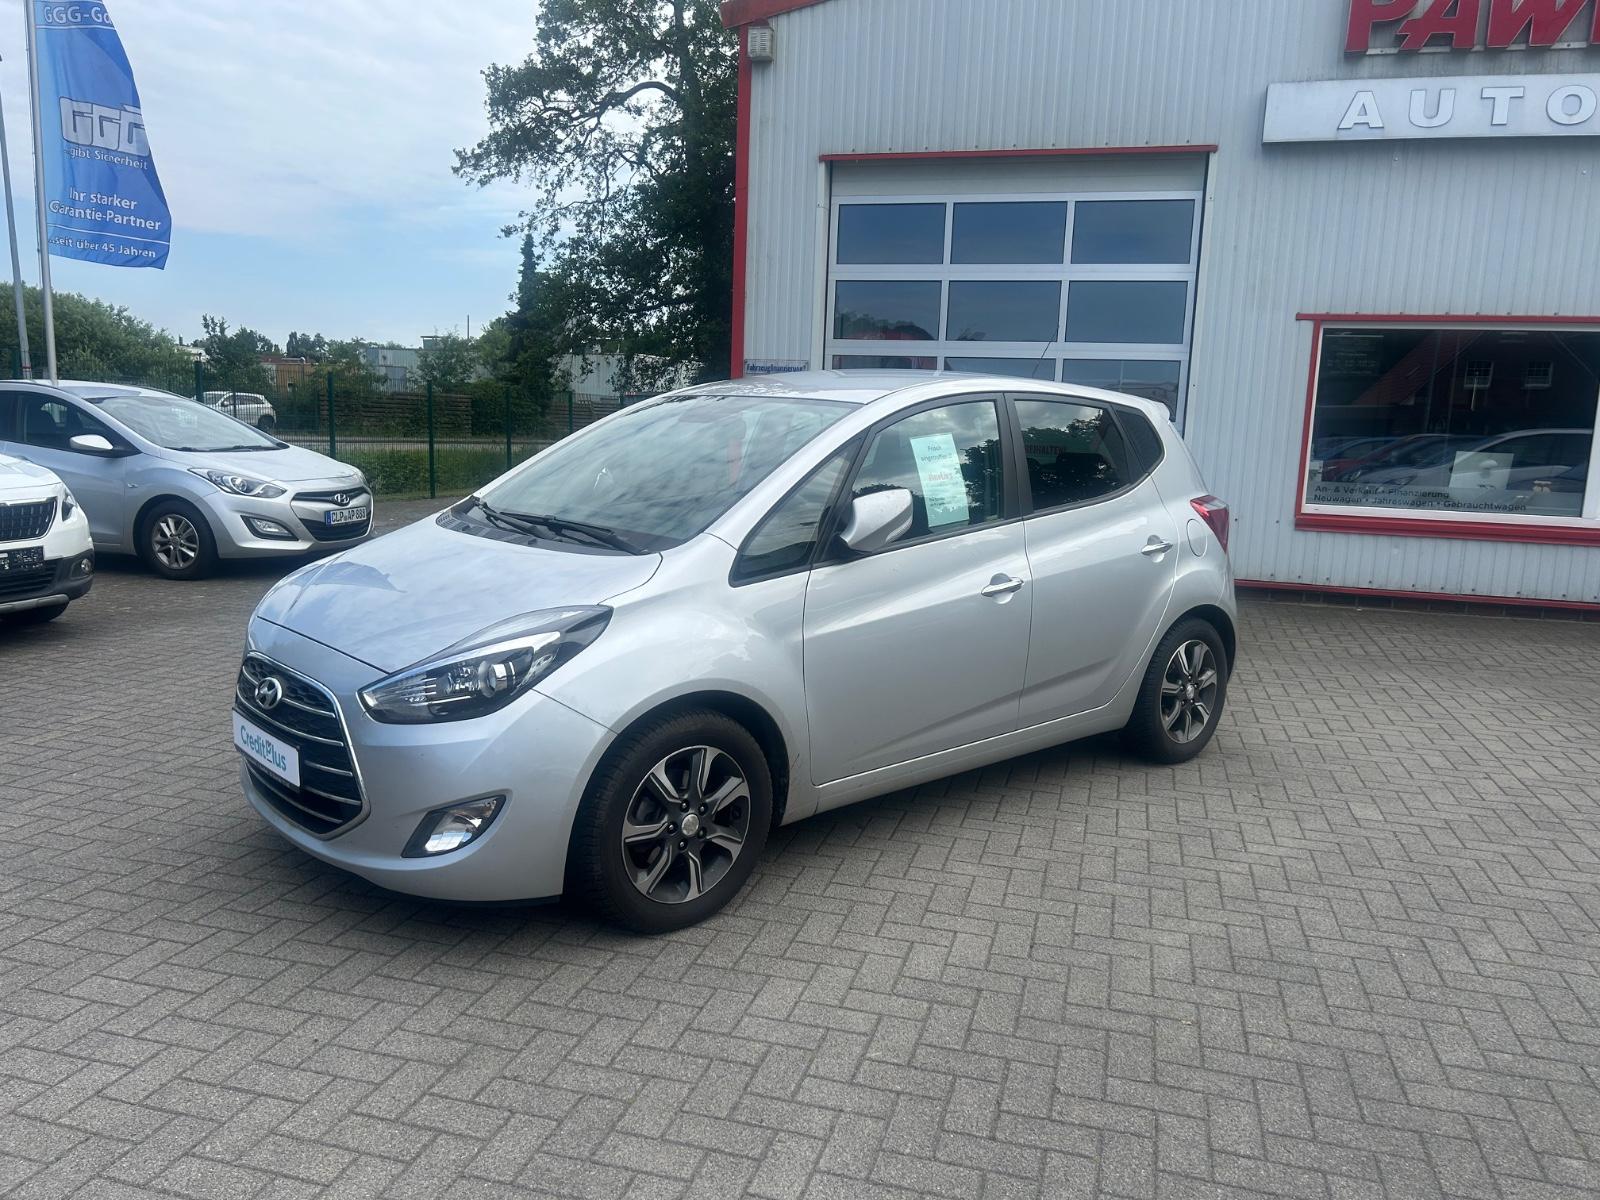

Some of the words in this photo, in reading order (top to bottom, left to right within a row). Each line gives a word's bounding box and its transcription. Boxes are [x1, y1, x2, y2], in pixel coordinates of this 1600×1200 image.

[1337, 84, 1598, 130] AUTO
[94, 150, 149, 170] Sicherheit
[69, 187, 86, 202] Ihr
[90, 192, 138, 210] starker
[49, 200, 161, 230] Garantie-Partner
[76, 238, 100, 250] über
[101, 242, 115, 252] 45
[118, 245, 157, 258] Jahren
[1314, 494, 1362, 505] Neuwagen
[1444, 500, 1527, 512] Gebrauchtwagen
[1388, 489, 1450, 500] Finanzierung
